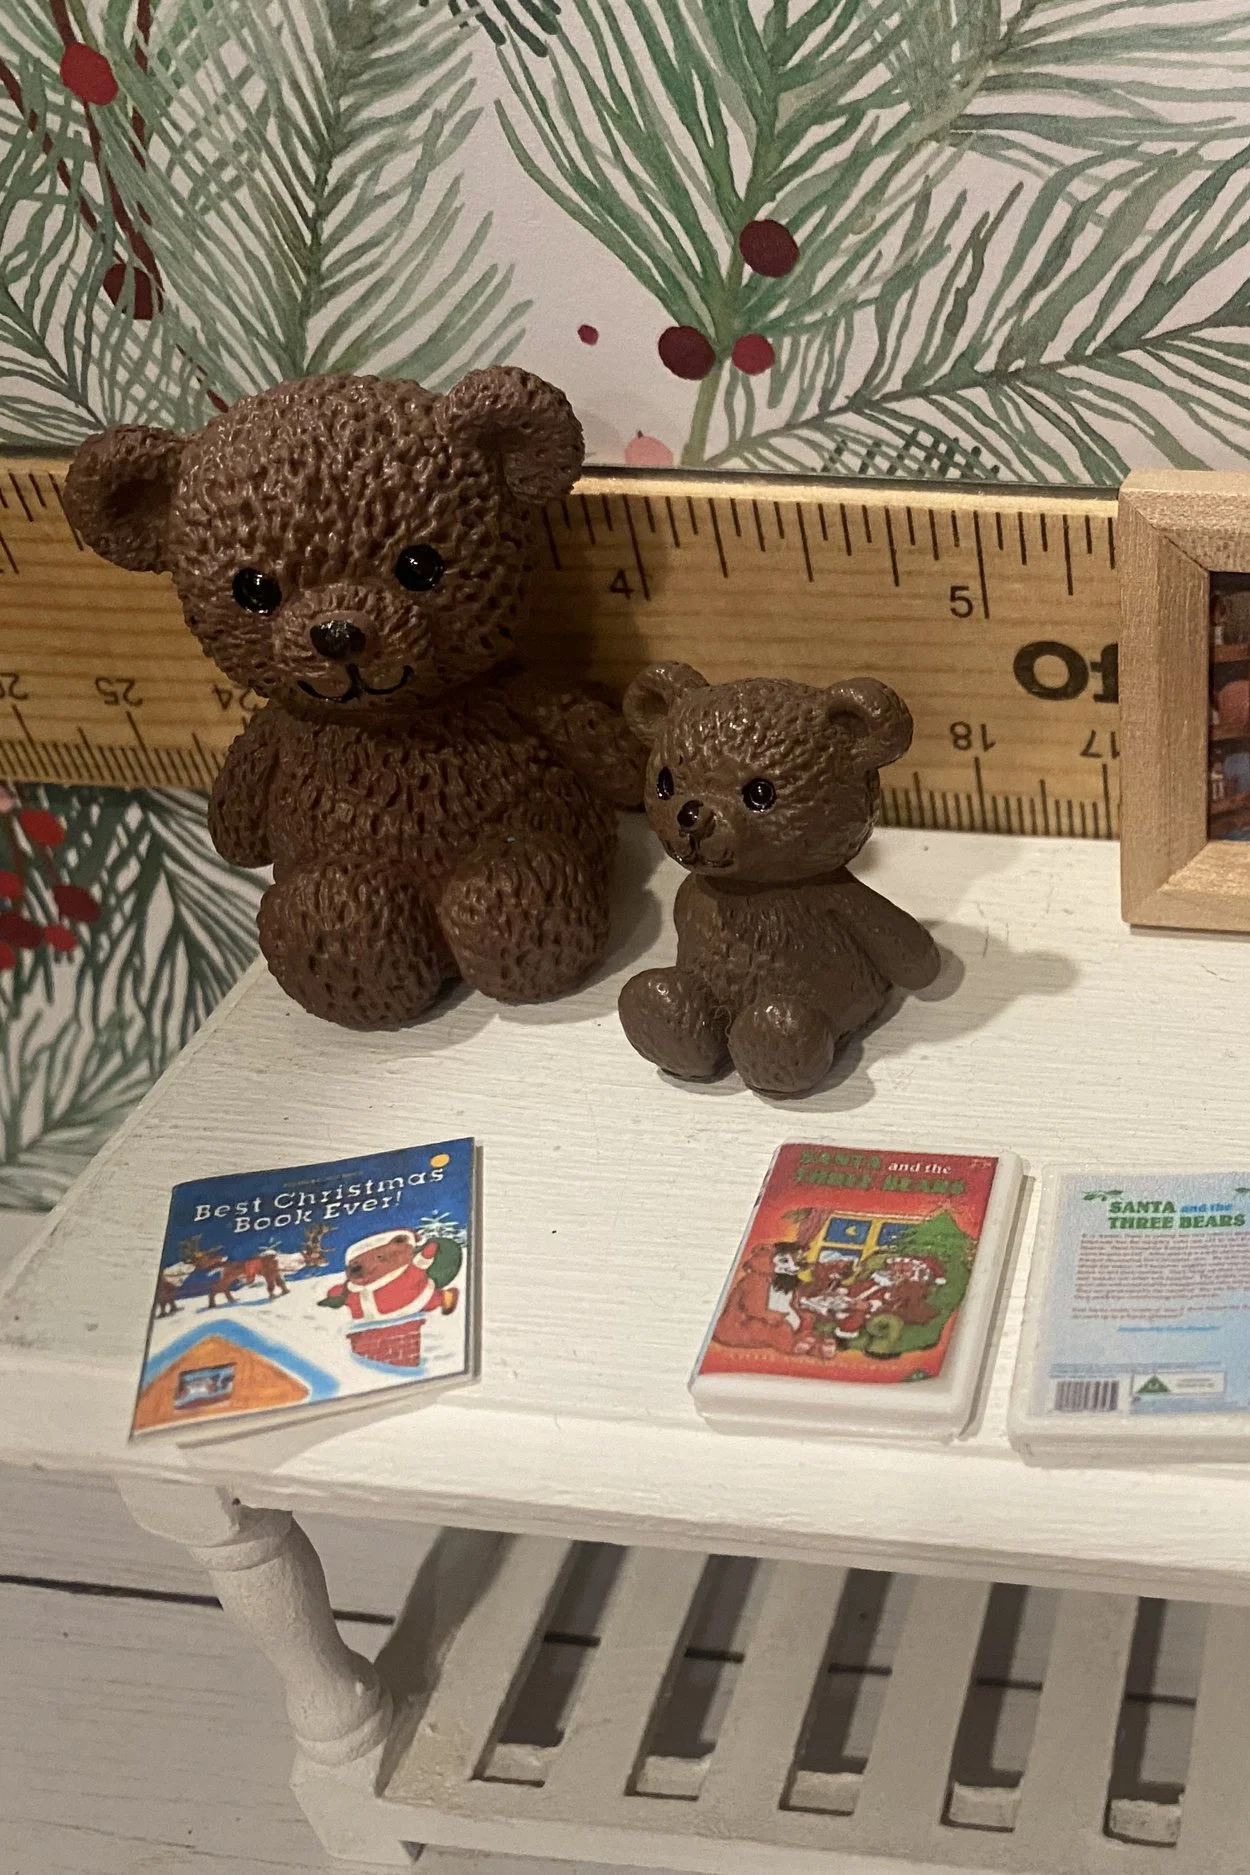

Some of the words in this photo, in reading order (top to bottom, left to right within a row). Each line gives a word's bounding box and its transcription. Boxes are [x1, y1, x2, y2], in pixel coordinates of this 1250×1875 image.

[610, 569, 635, 601] 4
[950, 585, 974, 619] 5
[95, 676, 143, 708] 25
[949, 720, 997, 752] 18
[1080, 729, 1120, 760] 17
[887, 1160, 921, 1174] and
[924, 1161, 953, 1176] the
[194, 1197, 262, 1223] Best
[274, 1167, 445, 1209] Christmas
[1108, 1200, 1176, 1214] SANTA
[1180, 1203, 1208, 1213] and
[1208, 1202, 1233, 1212] the
[233, 1209, 313, 1234] Book
[323, 1190, 404, 1220] Ever!
[1107, 1215, 1175, 1230] THREE
[1178, 1213, 1247, 1229] BEARS
